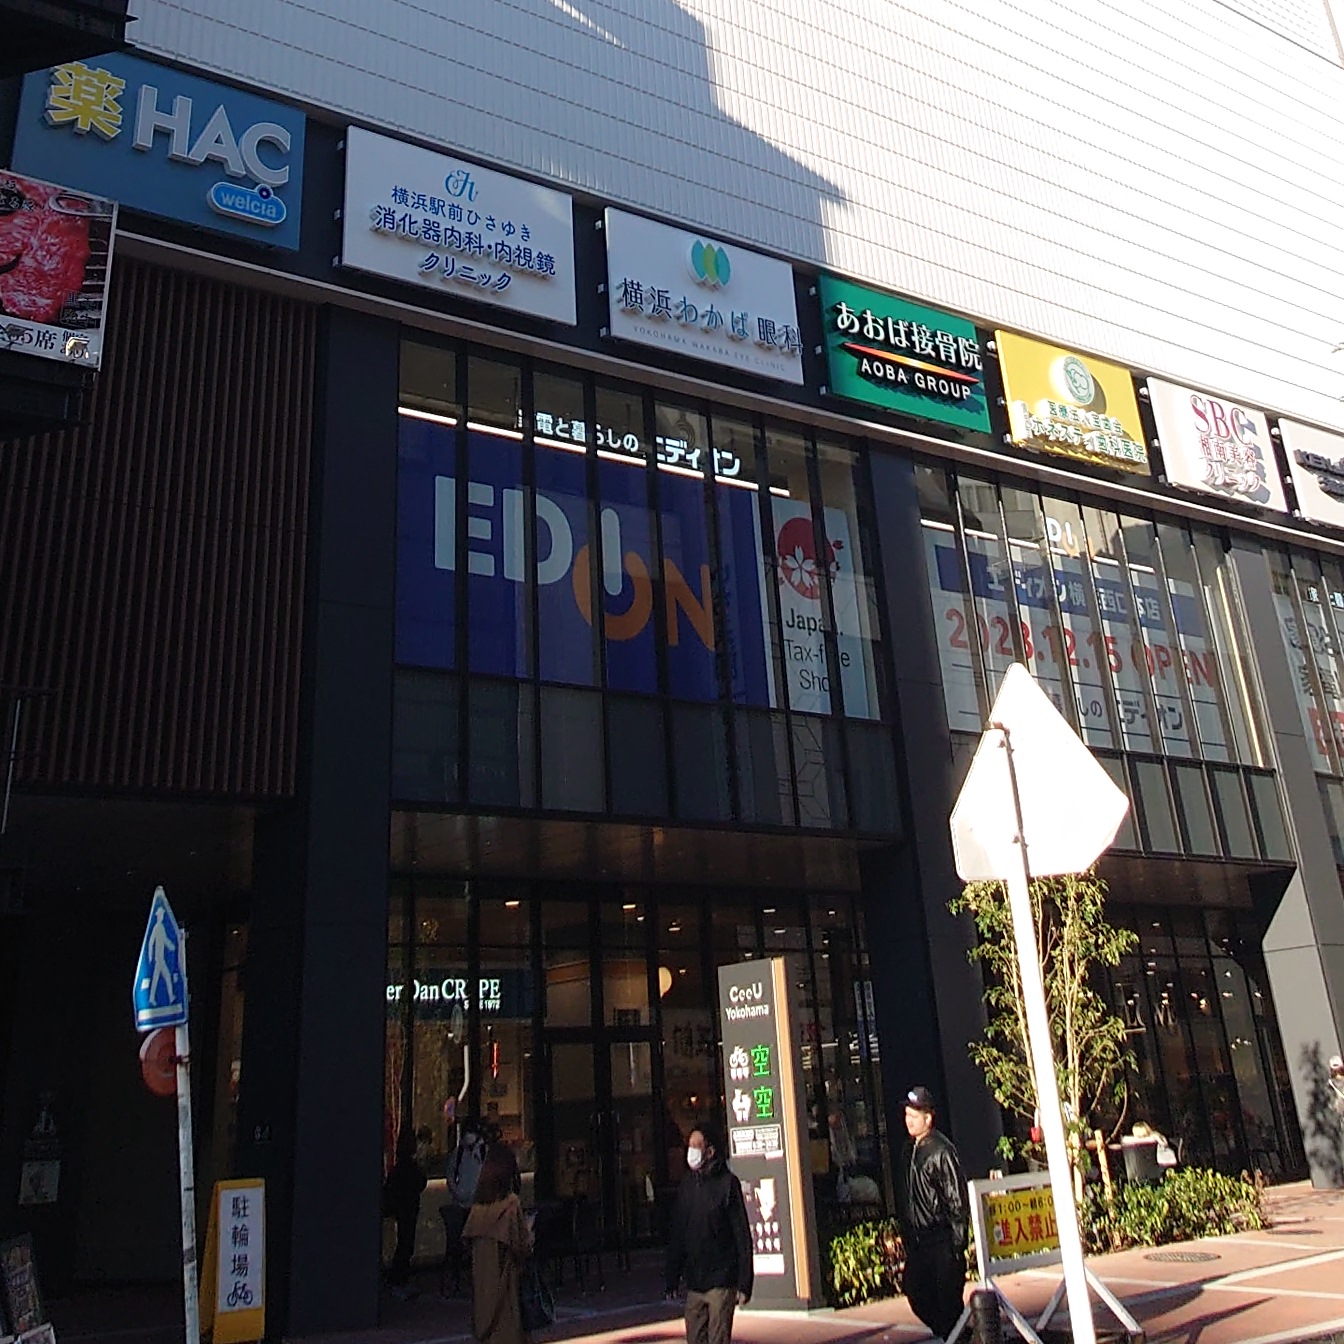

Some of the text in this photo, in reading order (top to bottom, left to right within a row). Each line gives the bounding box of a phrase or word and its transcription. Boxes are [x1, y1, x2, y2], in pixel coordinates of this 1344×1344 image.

[45, 60, 292, 187] 薬 HAC
[216, 188, 279, 219] welcia
[391, 185, 533, 242] 横浜駅前ひさゆき
[375, 205, 557, 278] 消化器内科・内視鏡
[421, 252, 513, 293] クリニック
[621, 277, 804, 355] 横浜わかば眼科
[834, 301, 983, 372] あおば接骨院
[861, 357, 972, 401] AOBA GROUP
[518, 408, 639, 453] 電と暮らしの
[1189, 394, 1256, 446] SBC
[434, 475, 716, 653] EDION
[441, 978, 502, 1000] CRPE
[729, 982, 763, 1003] CeeU
[725, 1004, 770, 1021] Yokohama
[751, 1044, 771, 1077] 空
[753, 1085, 774, 1118] 空
[230, 1196, 250, 1277] 駐輪場
